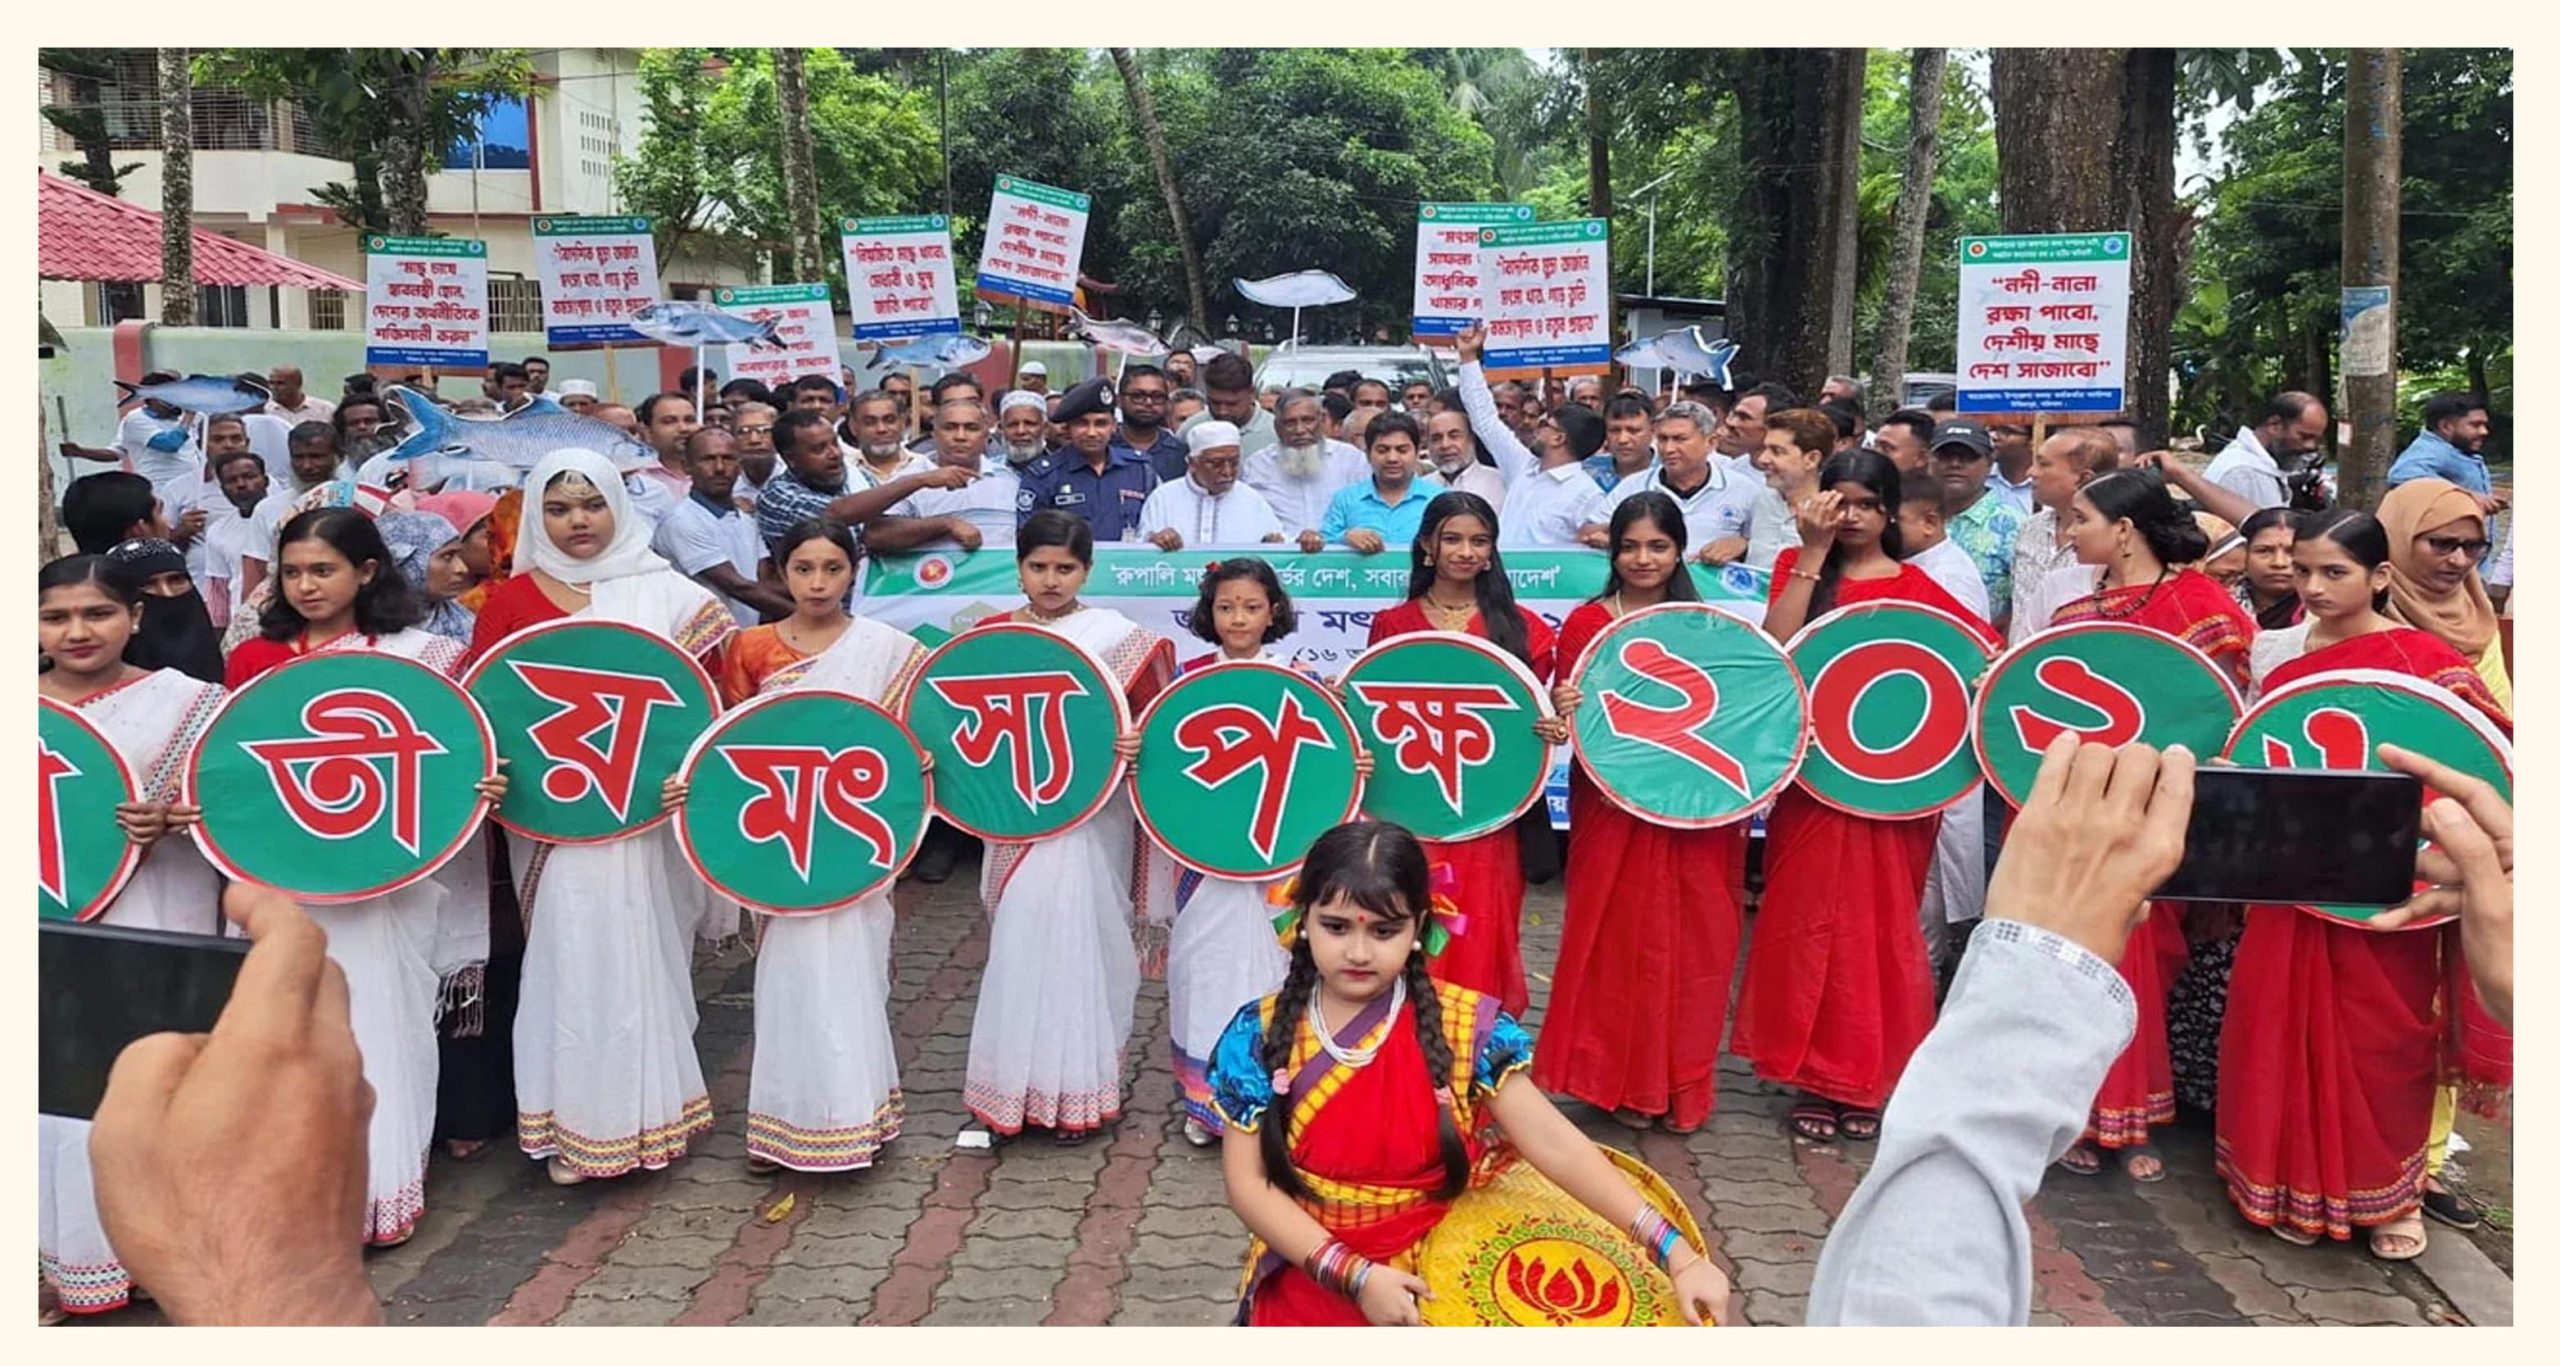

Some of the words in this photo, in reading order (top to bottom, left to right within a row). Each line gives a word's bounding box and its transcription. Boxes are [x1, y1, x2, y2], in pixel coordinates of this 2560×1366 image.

[1986, 304, 2031, 325] রক্ষা
[1984, 326, 2045, 352] দেশীয়
[2053, 332, 2100, 353] মাছে
[1969, 362, 2010, 380] দেশ
